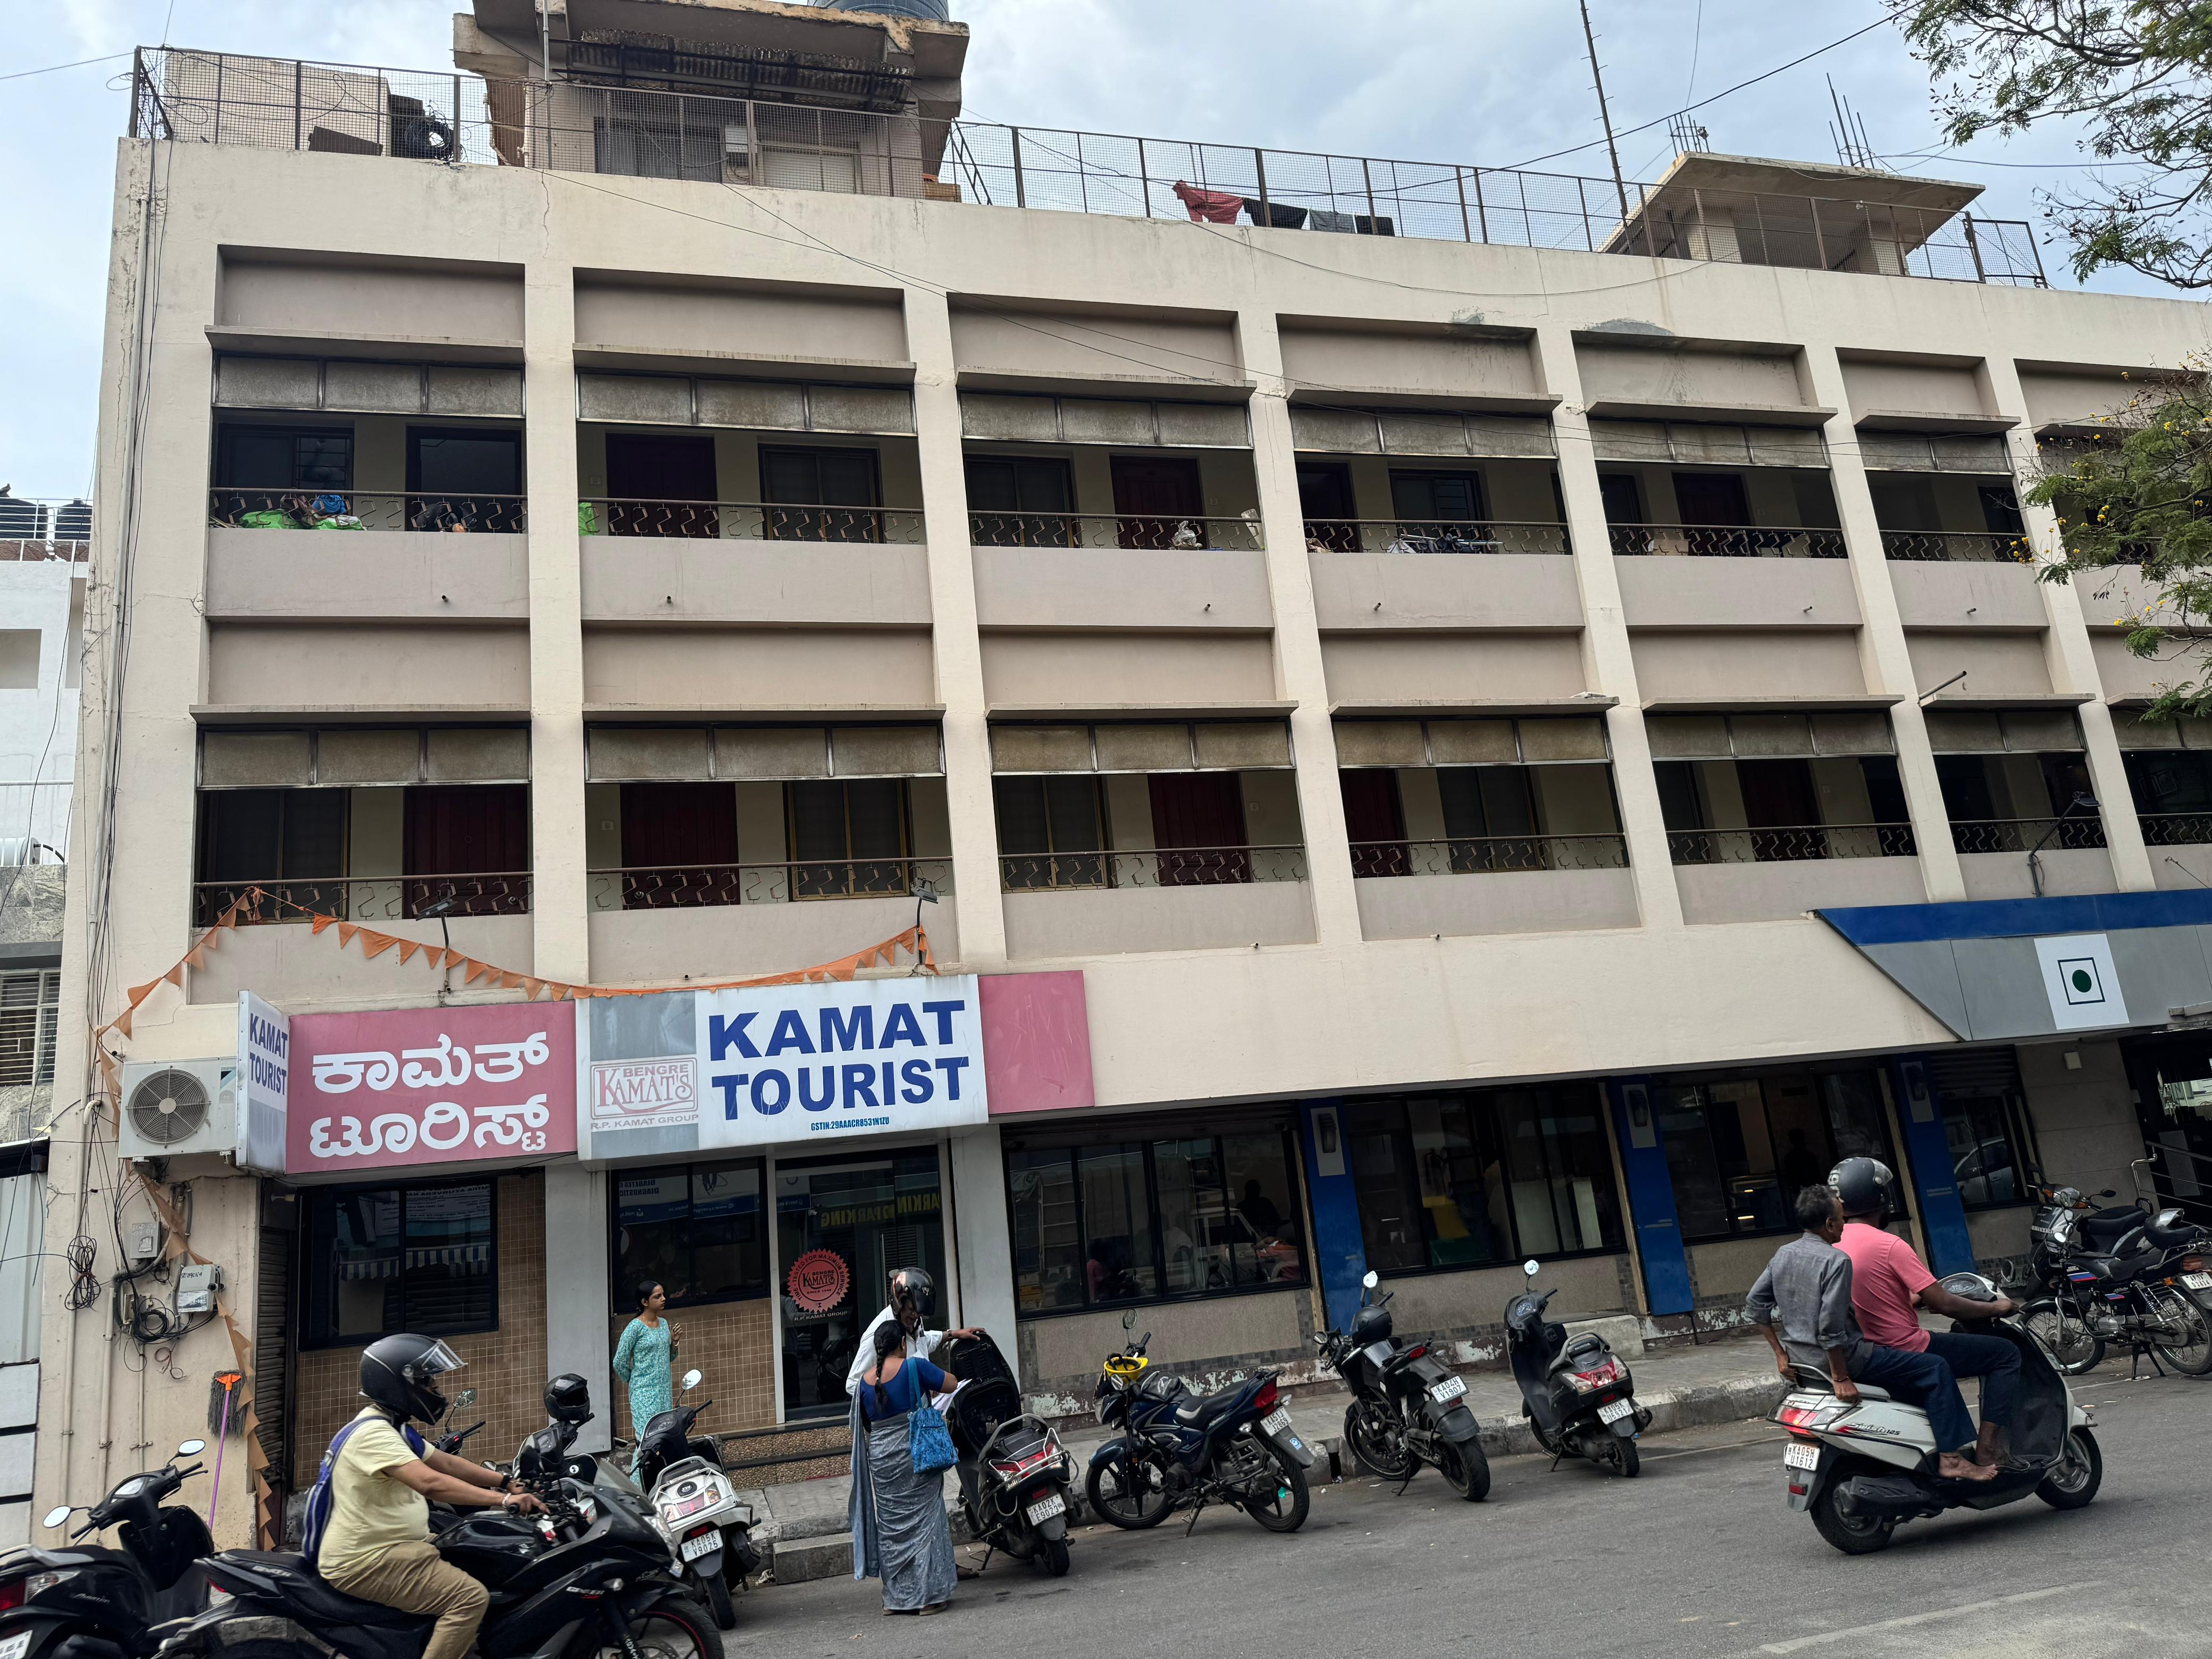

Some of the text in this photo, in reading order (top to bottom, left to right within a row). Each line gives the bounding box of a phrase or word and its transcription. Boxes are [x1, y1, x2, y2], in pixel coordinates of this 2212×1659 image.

[250, 1012, 288, 1059] KAMAT
[709, 1000, 965, 1061] KAMAT
[313, 1032, 549, 1093] ಕಾಮತ್
[623, 1064, 689, 1077] BENGRE
[250, 1052, 287, 1095] TOURIST
[596, 1068, 693, 1111] KAMAT'S
[711, 1057, 969, 1120] TOURIST
[615, 1118, 655, 1127] KAMAT
[658, 1115, 699, 1123] GROUP
[818, 1254, 842, 1270] MAXIMUM
[792, 1261, 805, 1283] TESTED
[793, 1288, 802, 1301] TIME
[1436, 1378, 1459, 1393] KA04H
[1440, 1385, 1461, 1398] V1907
[1604, 1402, 1625, 1414] KA05K
[1267, 1410, 1284, 1425] KA51J
[1272, 1418, 1288, 1432] J2869
[1847, 1422, 1886, 1433] Swish
[1792, 1445, 1815, 1457] KA05H
[1791, 1455, 1812, 1468] U1612
[1033, 1497, 1055, 1514] KA02K
[1036, 1505, 1059, 1521] E9023
[691, 1531, 716, 1548] KA05K
[693, 1540, 718, 1556] V9025
